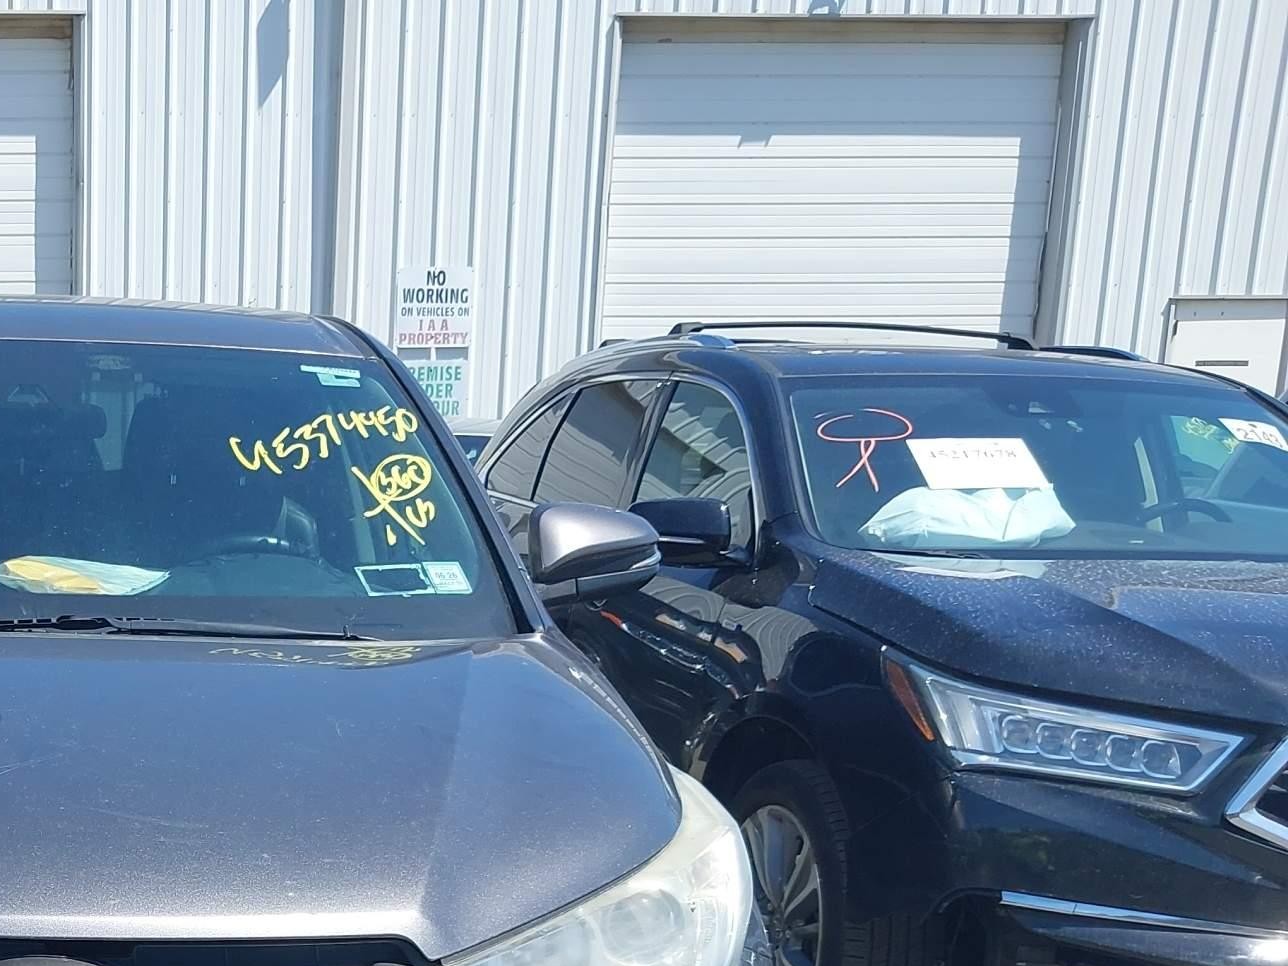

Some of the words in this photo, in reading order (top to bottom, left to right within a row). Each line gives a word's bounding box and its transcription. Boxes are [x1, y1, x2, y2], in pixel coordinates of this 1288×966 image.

[426, 270, 446, 286] NO
[402, 288, 468, 304] WORKING
[401, 307, 413, 317] ON
[416, 307, 455, 317] VEHICLES
[457, 307, 470, 317] ON
[399, 332, 468, 345] PROPERTY
[229, 405, 418, 475] 45374450
